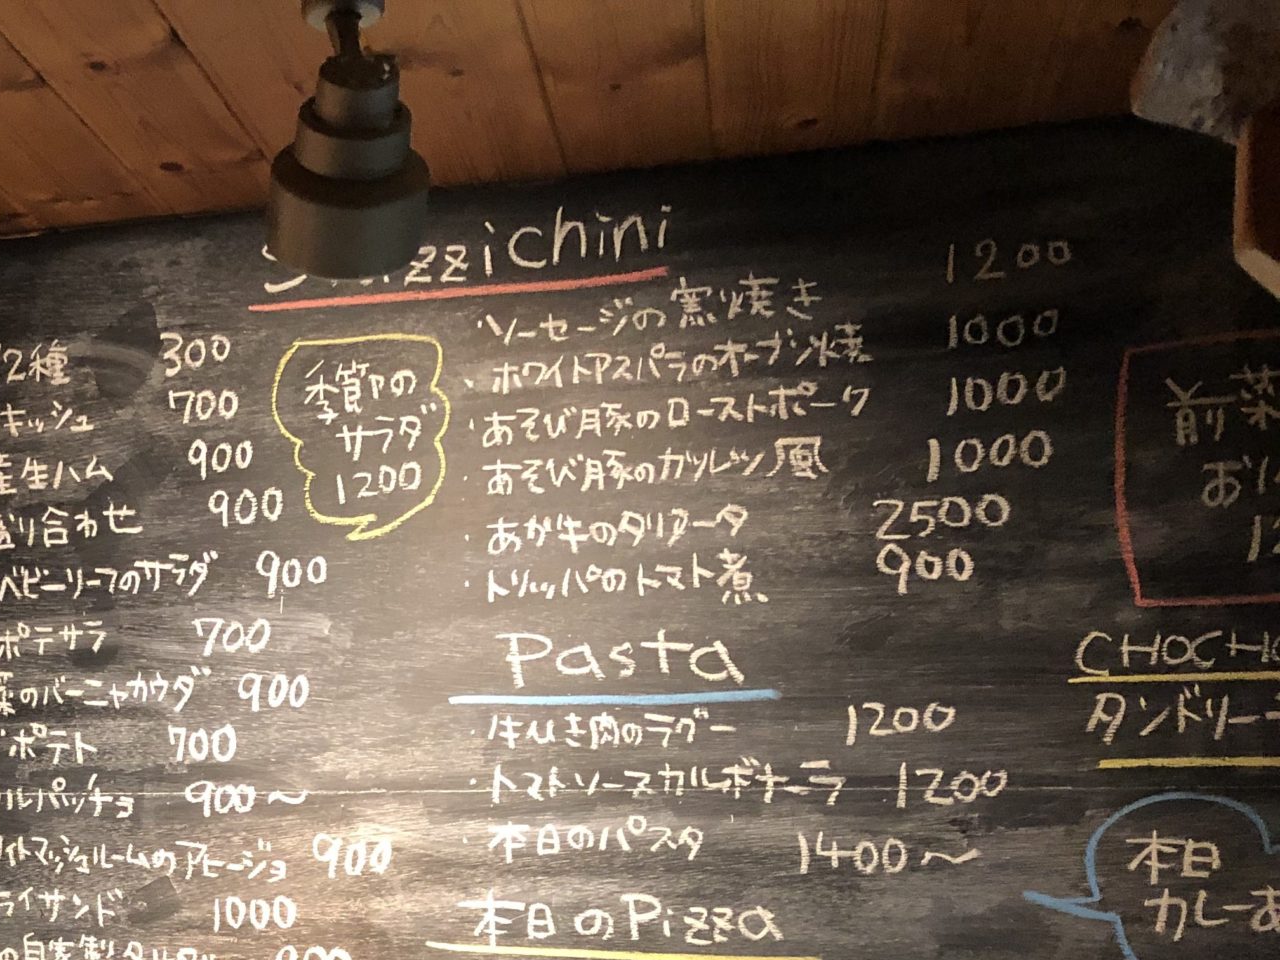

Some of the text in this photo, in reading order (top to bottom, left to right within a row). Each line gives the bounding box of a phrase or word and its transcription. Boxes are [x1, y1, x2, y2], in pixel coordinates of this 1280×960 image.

[261, 205, 672, 293] zzichini
[946, 238, 1074, 282] 1200
[947, 309, 1061, 349] 1000
[159, 332, 231, 378] 300
[168, 388, 239, 424] 700
[947, 363, 1067, 416] 1000
[336, 402, 437, 462] サラダ
[187, 439, 253, 480] 900
[926, 430, 1054, 483] 1000
[337, 461, 422, 505] 1200
[208, 487, 284, 528] 900
[873, 495, 1012, 540] 2500
[255, 549, 328, 599] 900
[875, 550, 975, 594] 900
[193, 617, 272, 659] 700
[495, 628, 746, 689] Pasta
[237, 672, 311, 714] 900
[168, 724, 237, 764] 700
[489, 700, 957, 748] 牛ひき肉のラグー 1200
[897, 761, 1009, 808] 1200
[312, 832, 393, 880] 900
[487, 815, 704, 863] 本日のパスタ
[1125, 830, 1222, 886] 本日
[213, 895, 298, 933] 1000
